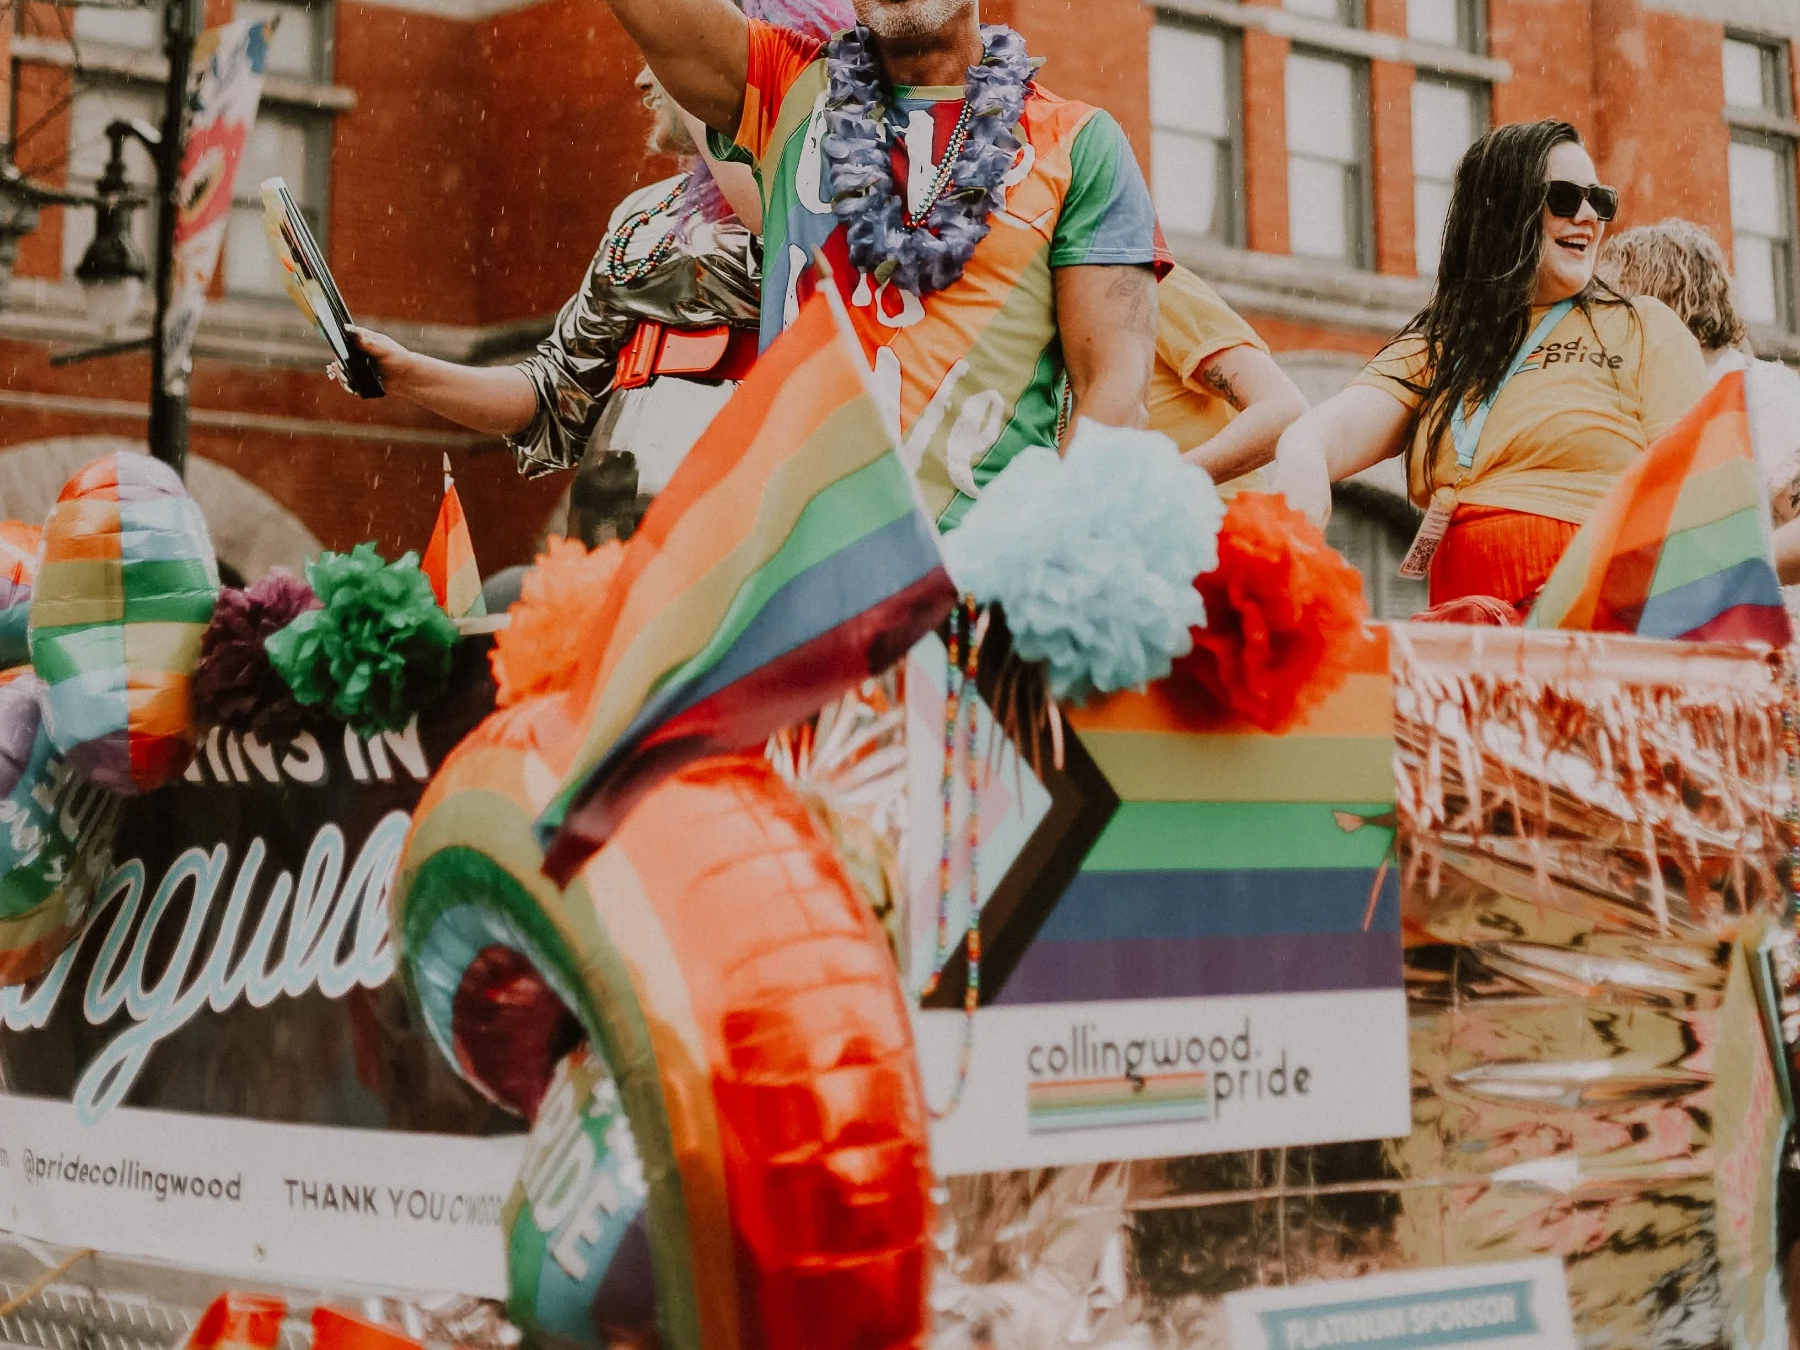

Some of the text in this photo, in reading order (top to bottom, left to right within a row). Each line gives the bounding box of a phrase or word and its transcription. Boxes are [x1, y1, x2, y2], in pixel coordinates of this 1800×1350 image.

[1541, 345, 1624, 369] pride
[1027, 1016, 1250, 1094] collingwood
[1213, 1049, 1311, 1121] pride
[22, 1147, 242, 1202] @pridecollingwood
[284, 1178, 379, 1216] THANK
[387, 1187, 446, 1223] YOU
[1286, 1292, 1517, 1350] PLATINUM SPONSOR
